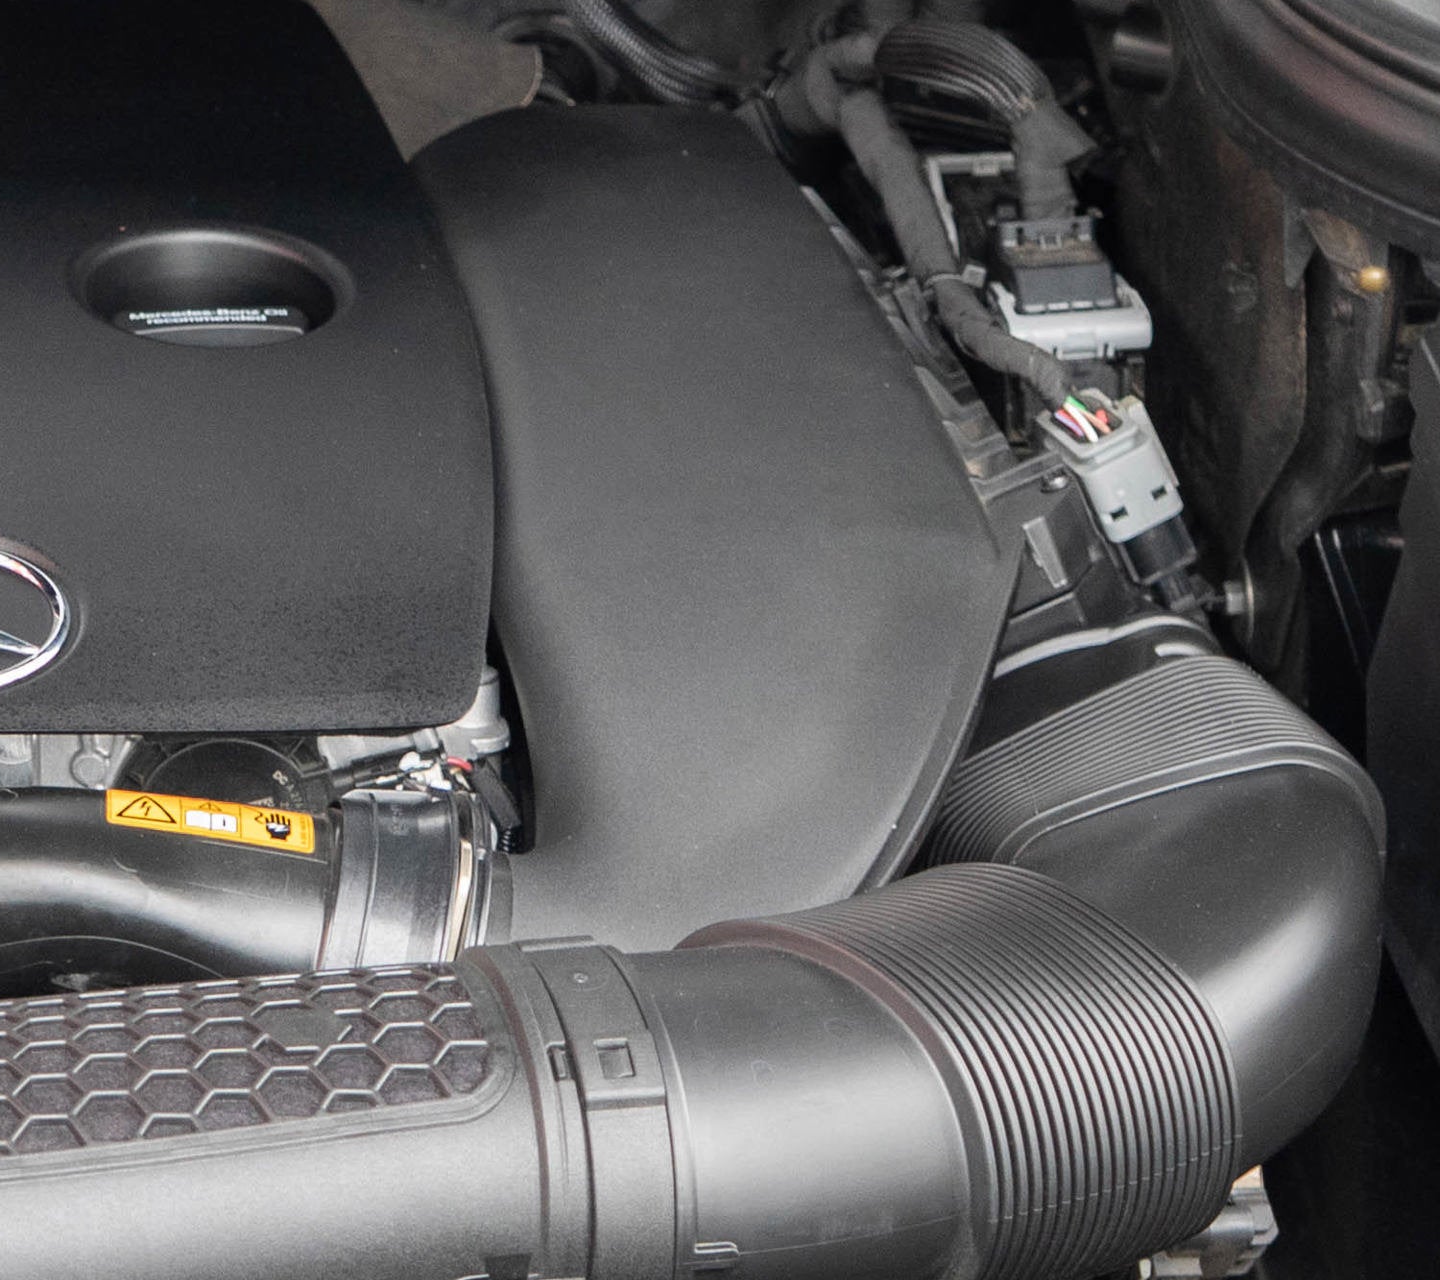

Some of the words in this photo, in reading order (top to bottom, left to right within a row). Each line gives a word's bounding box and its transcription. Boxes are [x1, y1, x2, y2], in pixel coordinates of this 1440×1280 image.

[129, 308, 260, 320] Mercedes-Benz
[264, 308, 288, 317] Oil
[146, 314, 268, 325] recommended
